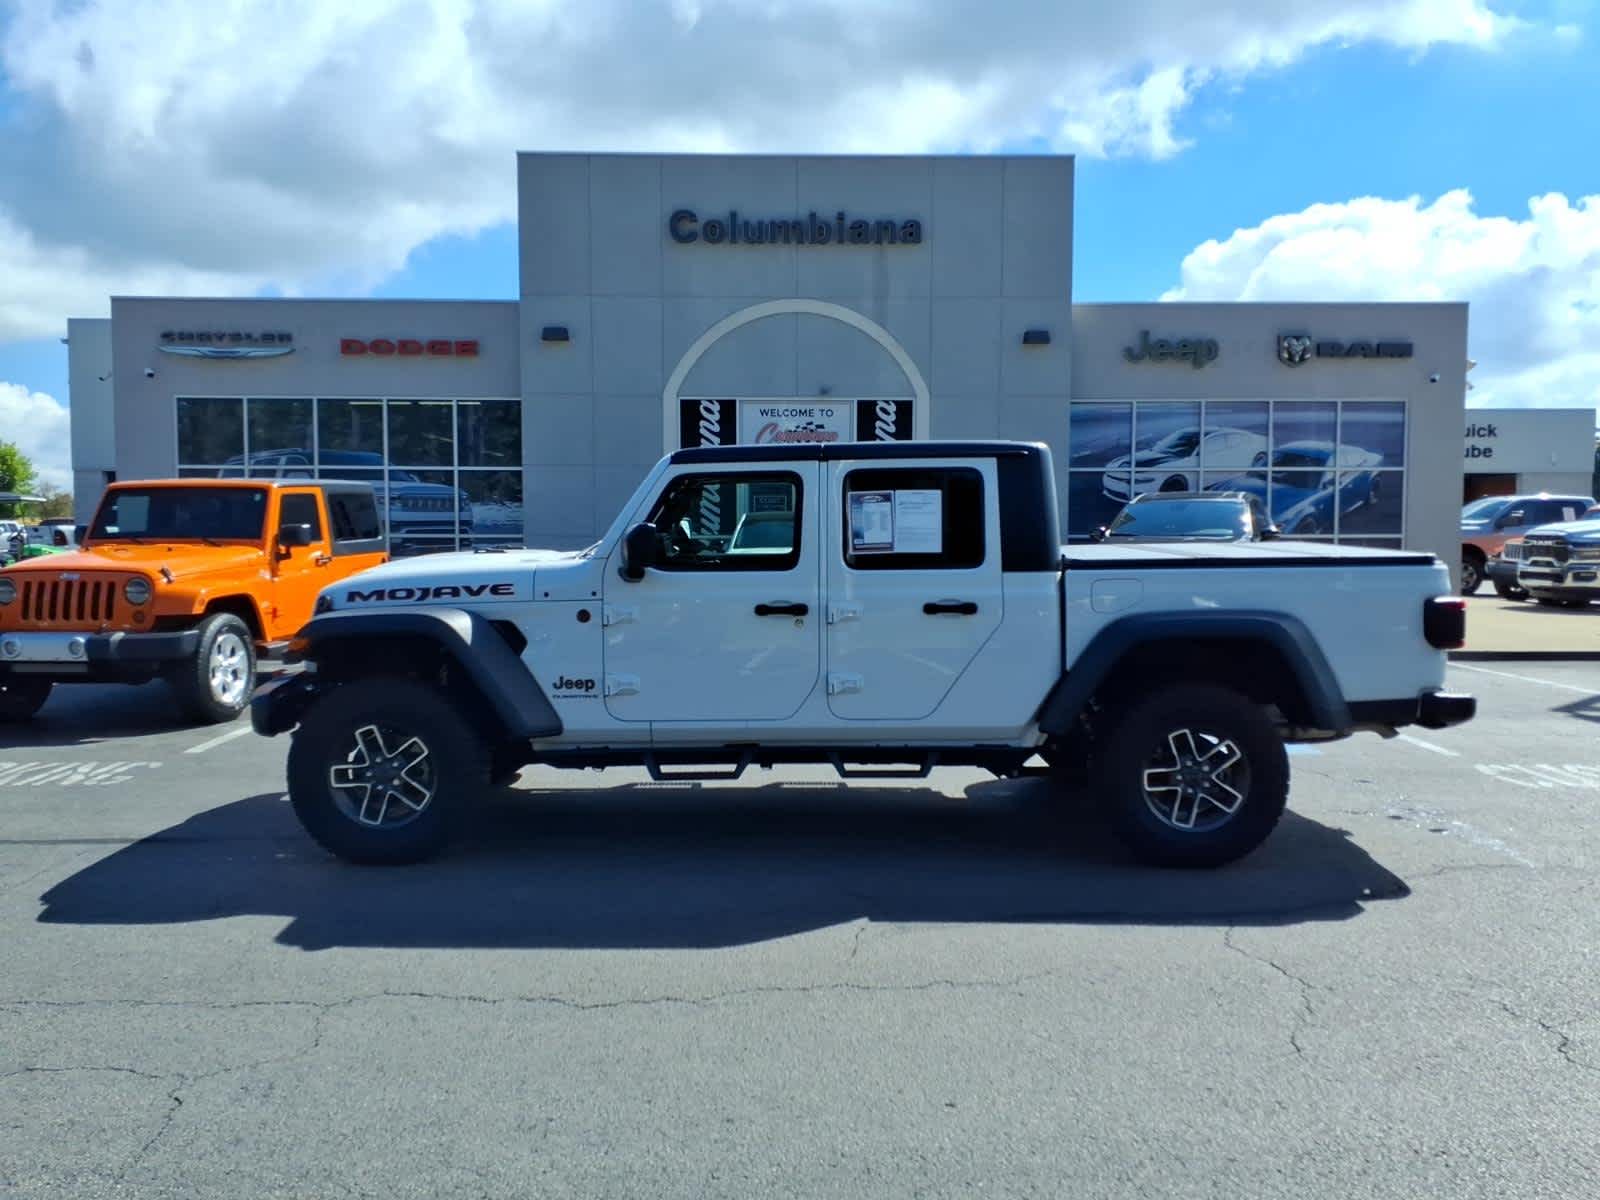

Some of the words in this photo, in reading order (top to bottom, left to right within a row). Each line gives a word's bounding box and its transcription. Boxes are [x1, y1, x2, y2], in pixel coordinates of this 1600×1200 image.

[670, 209, 922, 245] Columbiana
[160, 330, 294, 343] CHRYSLER
[340, 338, 479, 356] DODGE
[1123, 330, 1219, 369] Jeep
[1316, 342, 1414, 358] RAM
[759, 408, 814, 418] WELCOME
[819, 408, 834, 418] TO
[1464, 423, 1497, 438] uick
[1464, 444, 1493, 458] ube
[346, 583, 515, 603] MOJAVE
[552, 675, 595, 692] Jeep
